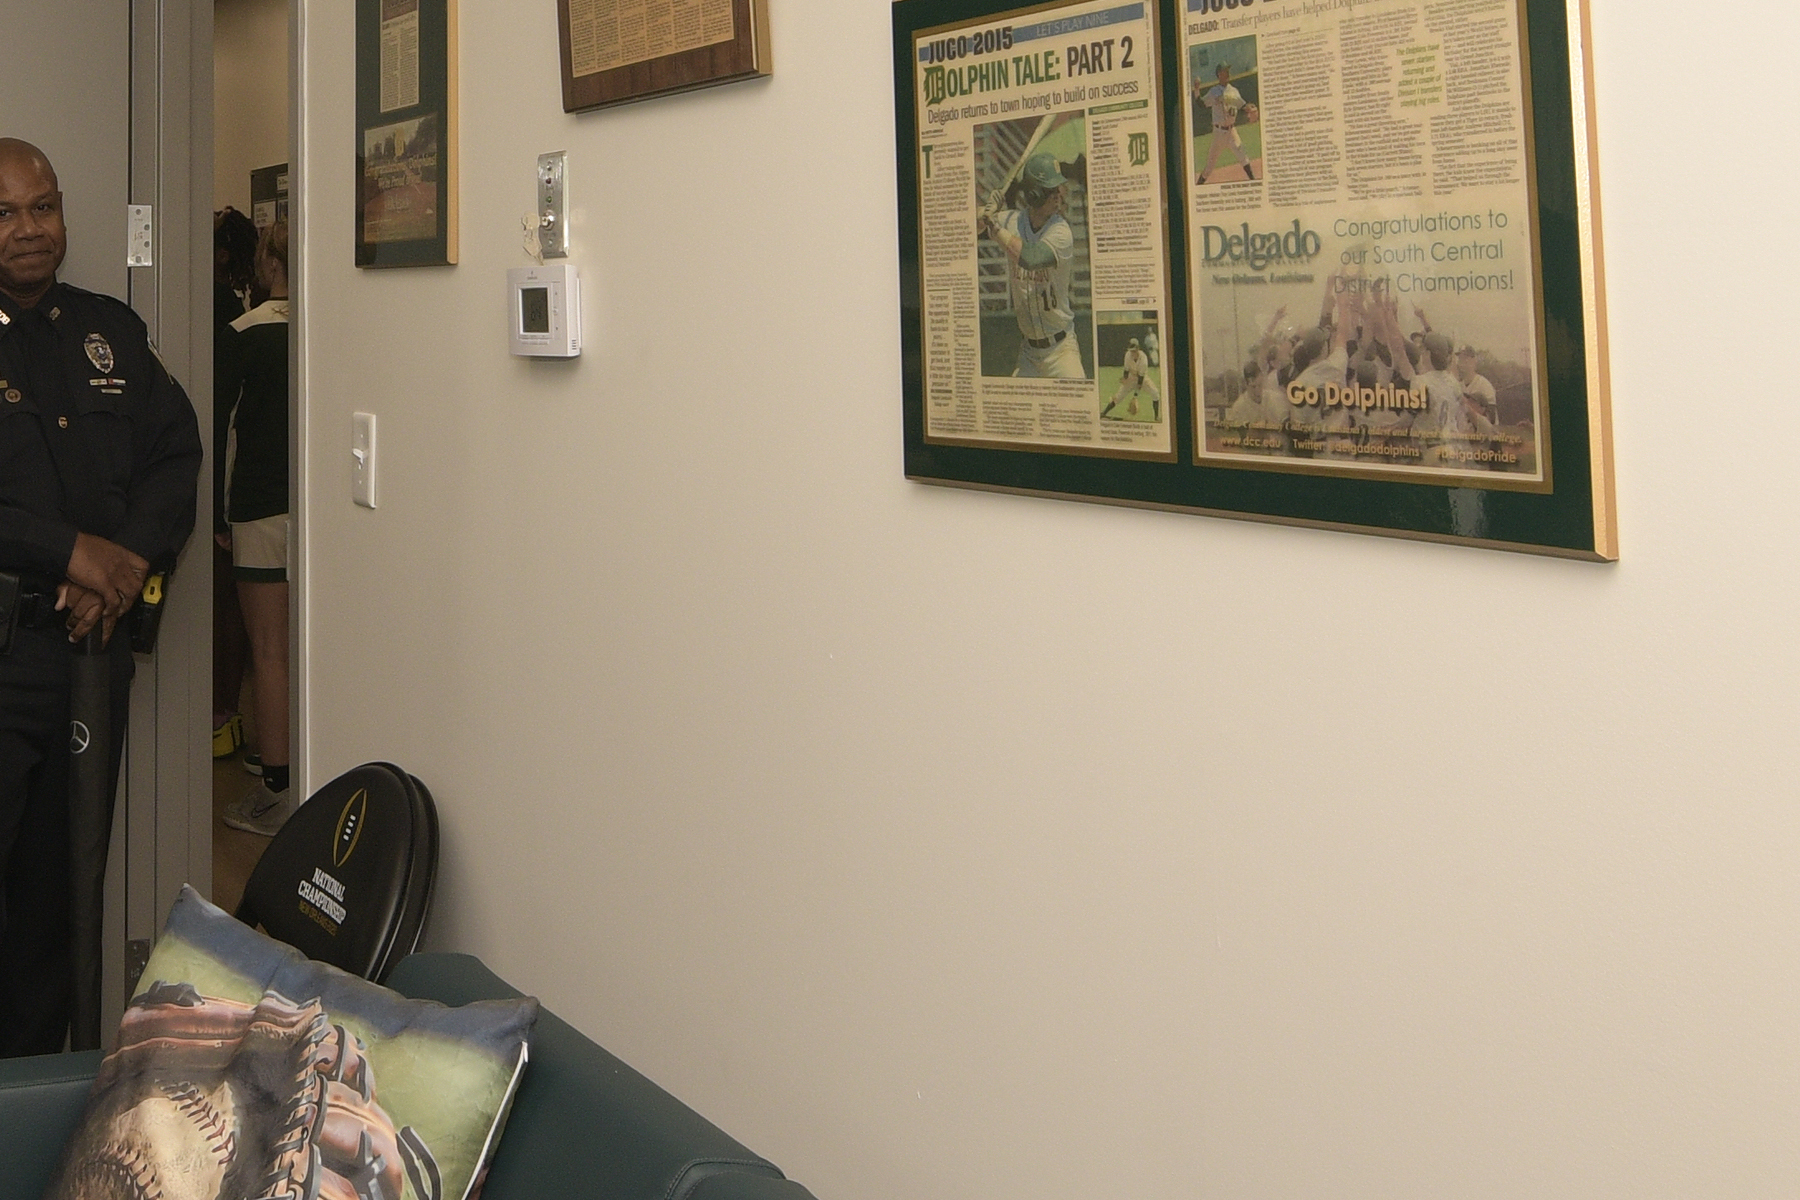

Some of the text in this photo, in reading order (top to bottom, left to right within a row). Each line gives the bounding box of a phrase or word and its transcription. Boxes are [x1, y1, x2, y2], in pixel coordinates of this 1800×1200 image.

[1036, 11, 1109, 37] LET'S PLAY NINE
[1188, 19, 1219, 35] DELGADO:
[1221, 13, 1253, 29] Transfer
[1254, 10, 1281, 29] players
[1282, 5, 1300, 19] have
[929, 26, 1013, 65] JUCO 2015
[923, 35, 1134, 107] DOLPHIN TALE: PART 2
[928, 80, 1139, 126] Delgado returns to town hoping to build on success
[1334, 208, 1508, 240] Congratulations to
[1200, 218, 1321, 271] Delgado
[1340, 238, 1503, 266] our South Central
[1333, 269, 1515, 296] District Champions!
[1286, 380, 1429, 412] Go Dolphins!
[1220, 436, 1282, 448] www.dcc.edu
[312, 867, 346, 902] NATIONAL
[298, 880, 347, 925] CHAMPIONSHIP
